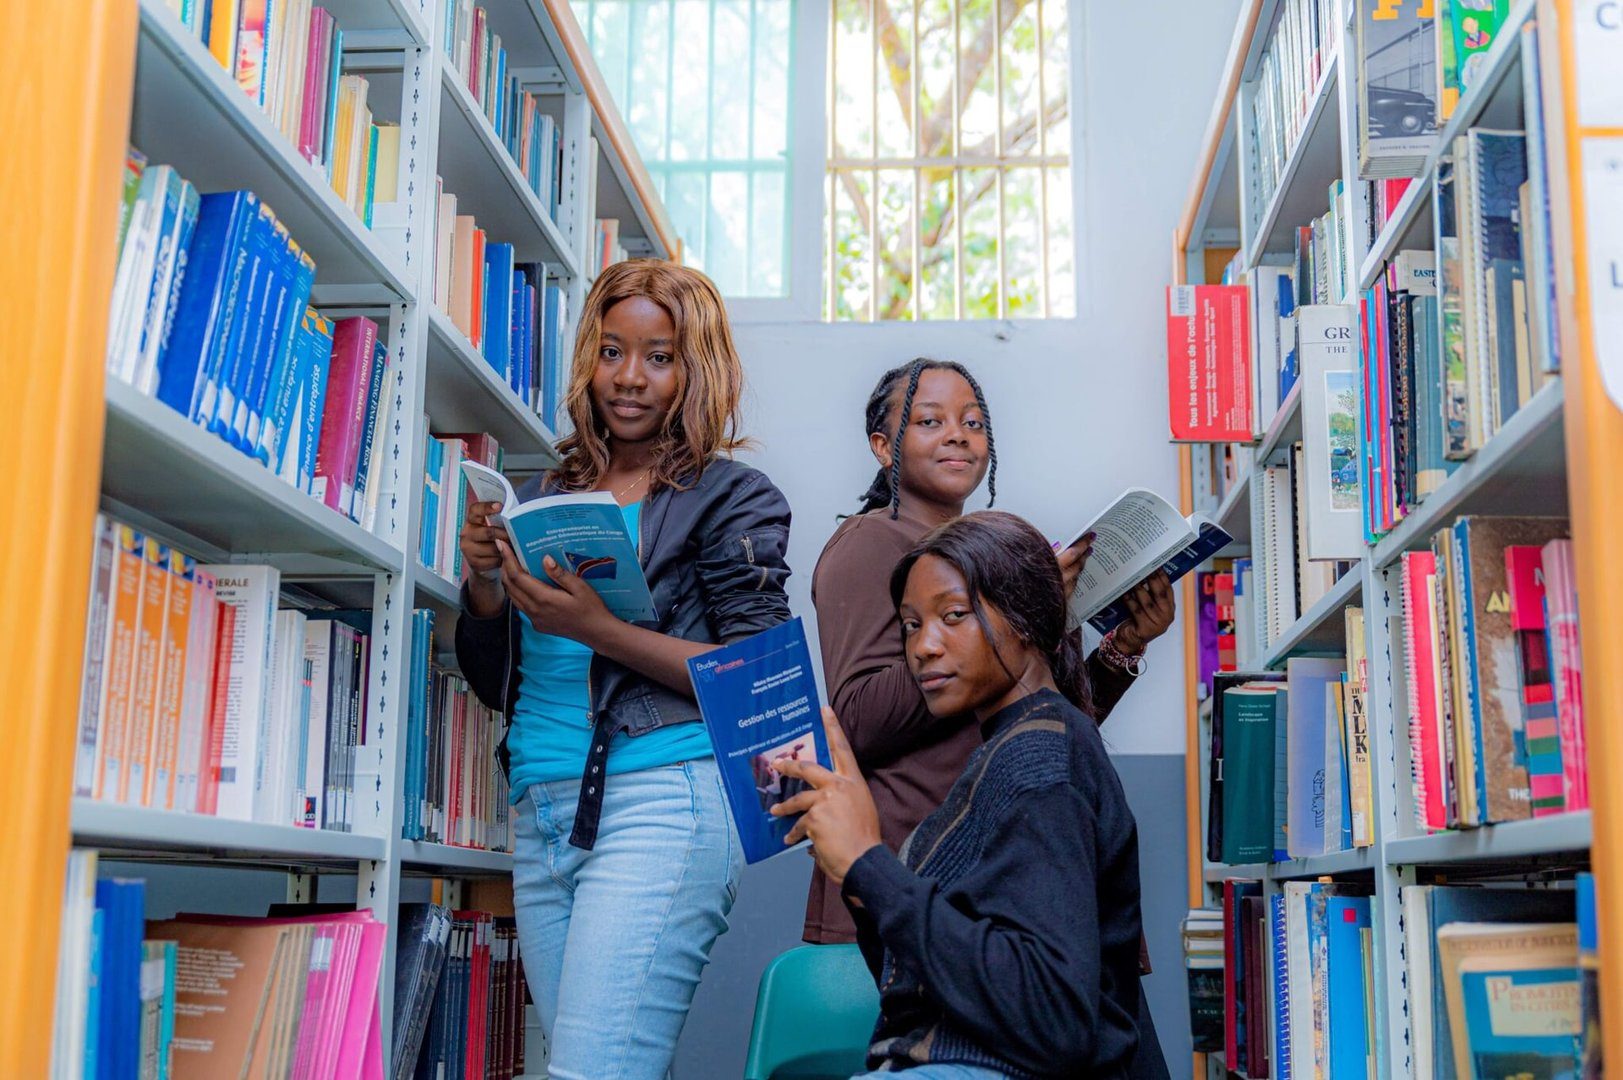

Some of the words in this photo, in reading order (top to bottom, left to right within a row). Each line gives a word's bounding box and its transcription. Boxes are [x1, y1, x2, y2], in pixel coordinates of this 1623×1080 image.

[359, 326, 373, 387] INTERNATIONAL
[1187, 344, 1196, 357] de
[371, 352, 384, 400] MANAGING
[1188, 359, 1198, 390] enjeux
[308, 364, 320, 432] d'entreprise
[354, 387, 365, 420] FINANCE
[1189, 392, 1198, 406] les
[365, 399, 378, 444] FINANCIAL
[1189, 408, 1198, 428] Tous
[362, 444, 372, 466] RISK
[738, 714, 765, 728] Gestion
[766, 707, 778, 719] des
[777, 696, 808, 714] ressources
[782, 706, 810, 723] humaines
[1508, 787, 1531, 800] THE
